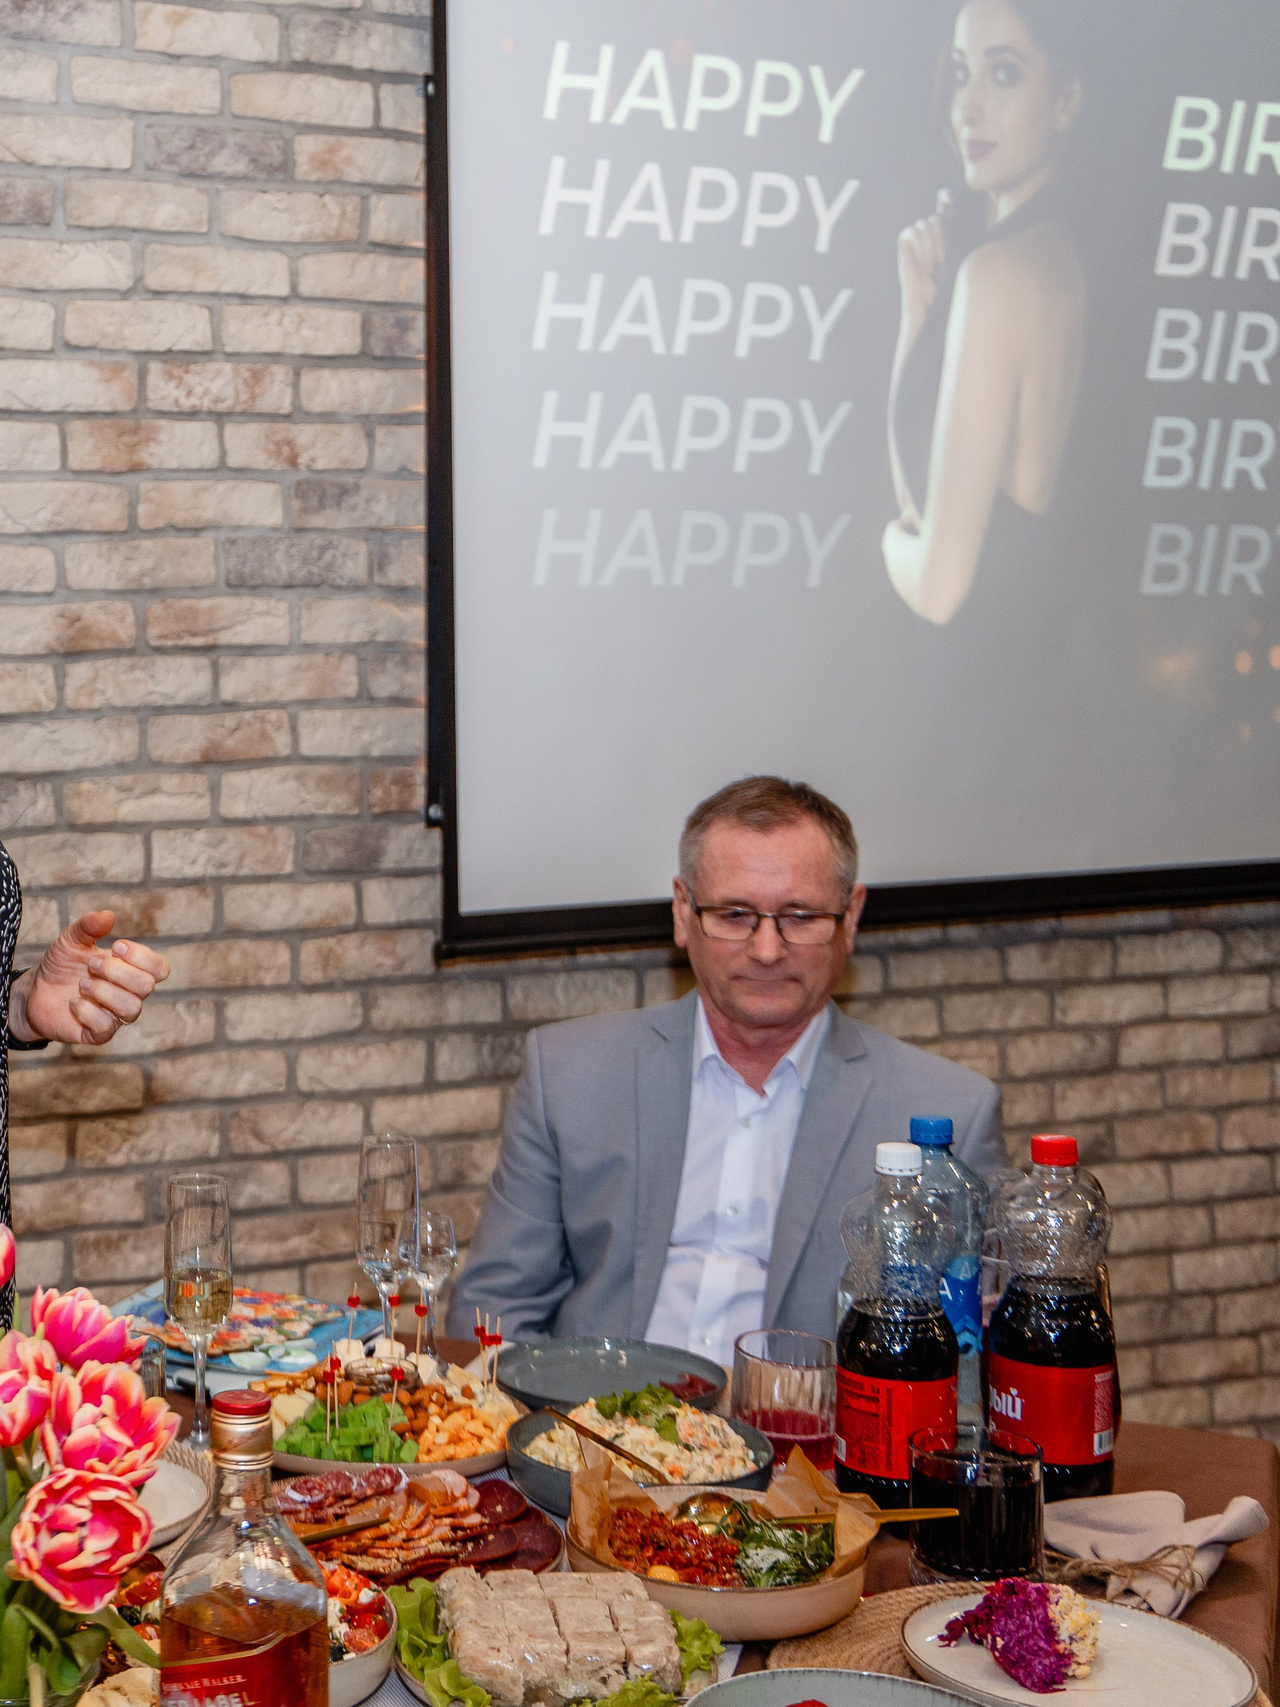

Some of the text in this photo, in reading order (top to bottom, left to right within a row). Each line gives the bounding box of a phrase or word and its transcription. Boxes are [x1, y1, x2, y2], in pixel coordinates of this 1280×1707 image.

[542, 40, 1280, 176] HAPPY BIR
[538, 156, 1280, 281] HAPPY BIR
[531, 271, 1280, 384] HAPPY BIR
[531, 390, 1280, 490] HAPPY BIR
[531, 509, 1280, 595] HAPPY BIR
